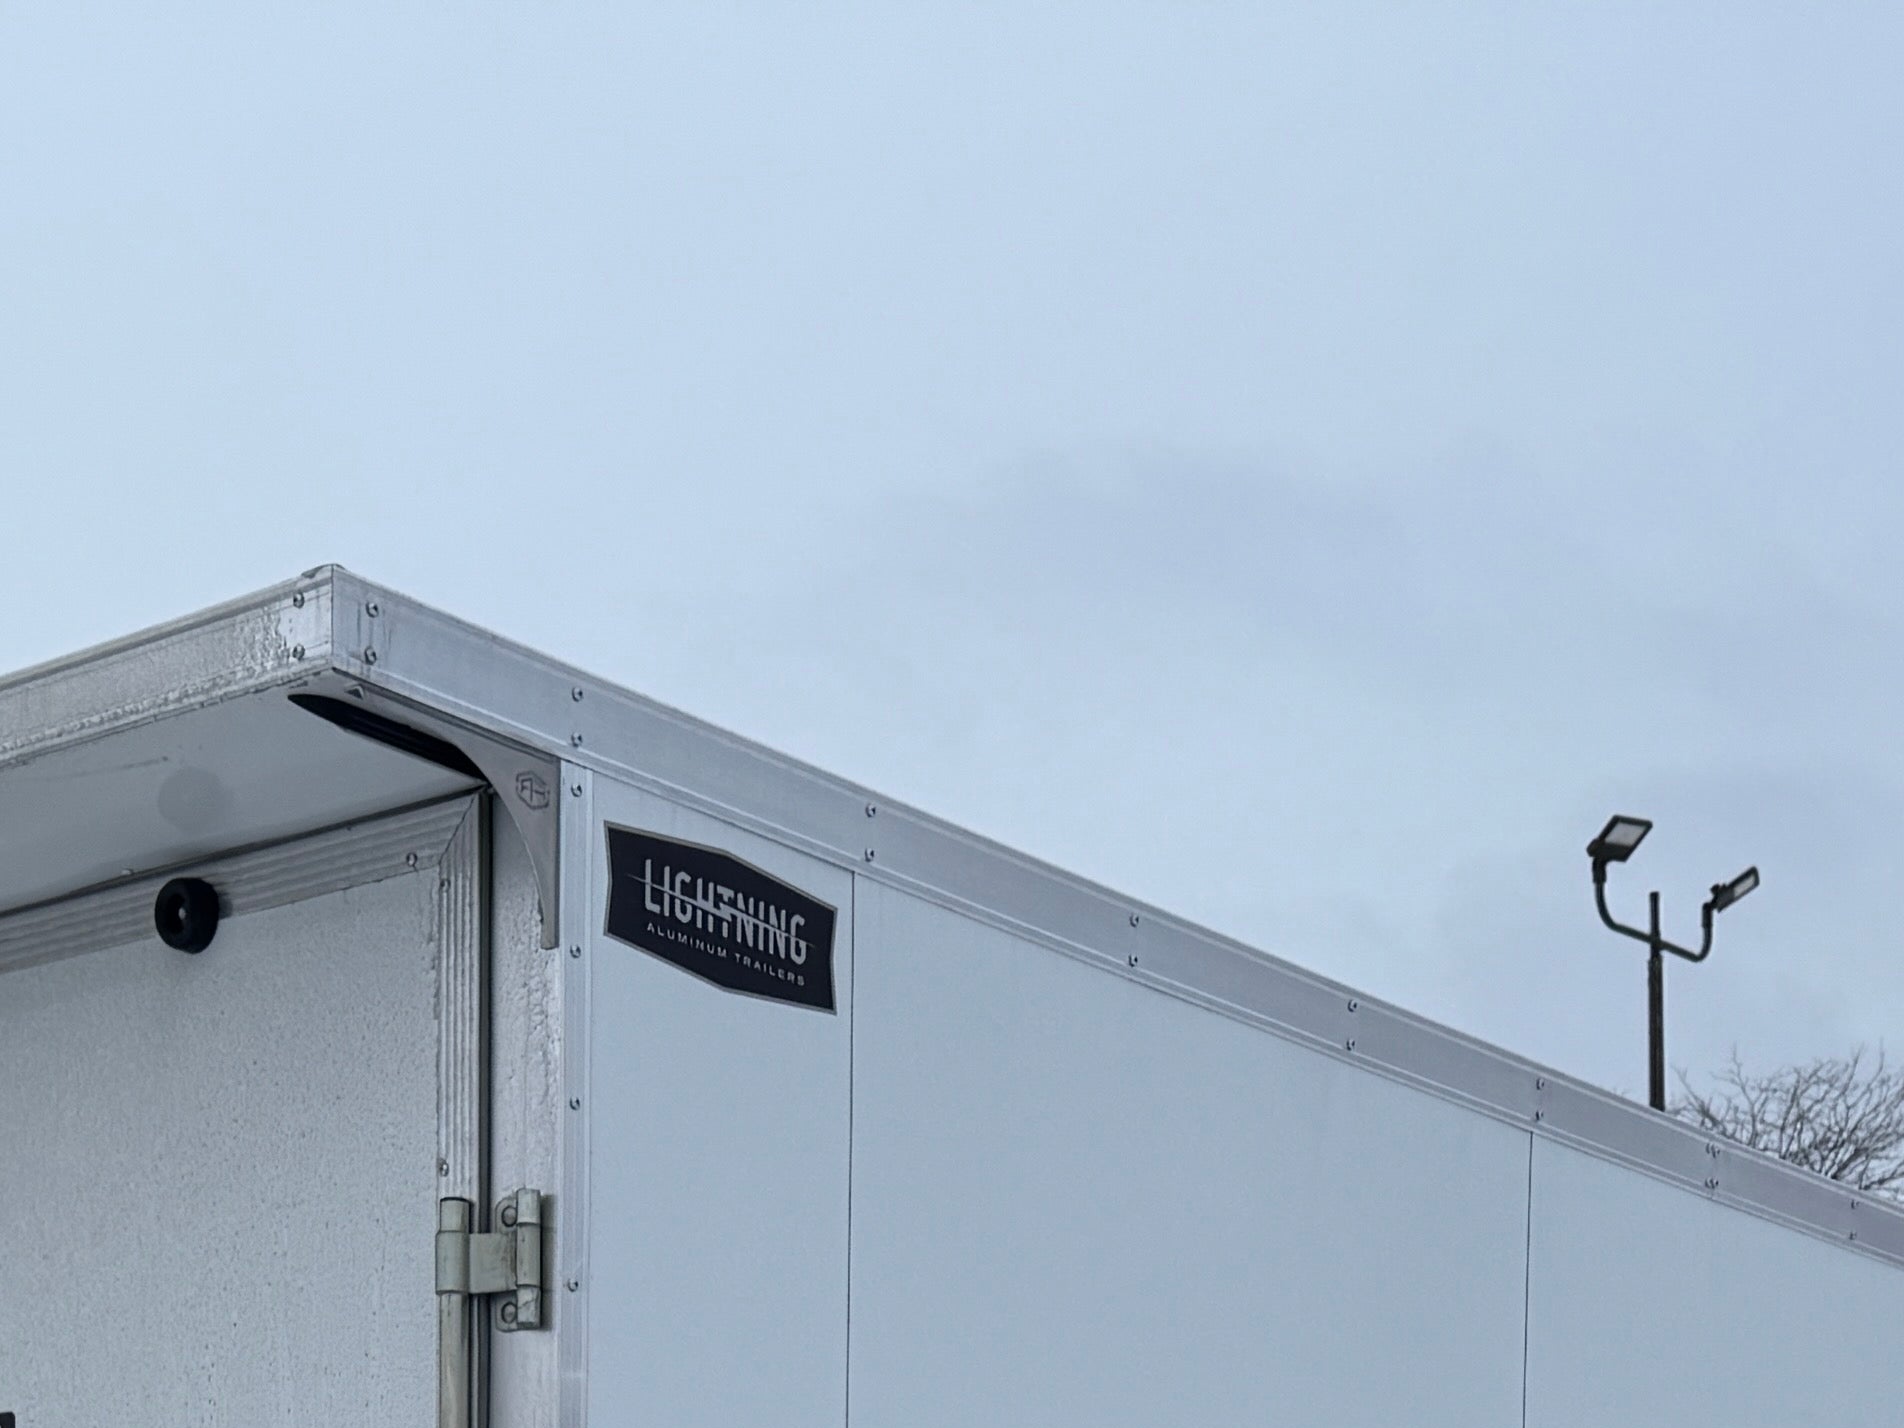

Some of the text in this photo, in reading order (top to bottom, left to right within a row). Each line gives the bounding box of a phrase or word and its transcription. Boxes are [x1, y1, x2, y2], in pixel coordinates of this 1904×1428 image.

[644, 858, 808, 966] LIGHTNING
[647, 922, 805, 987] ALUMINUM TRAILERS
